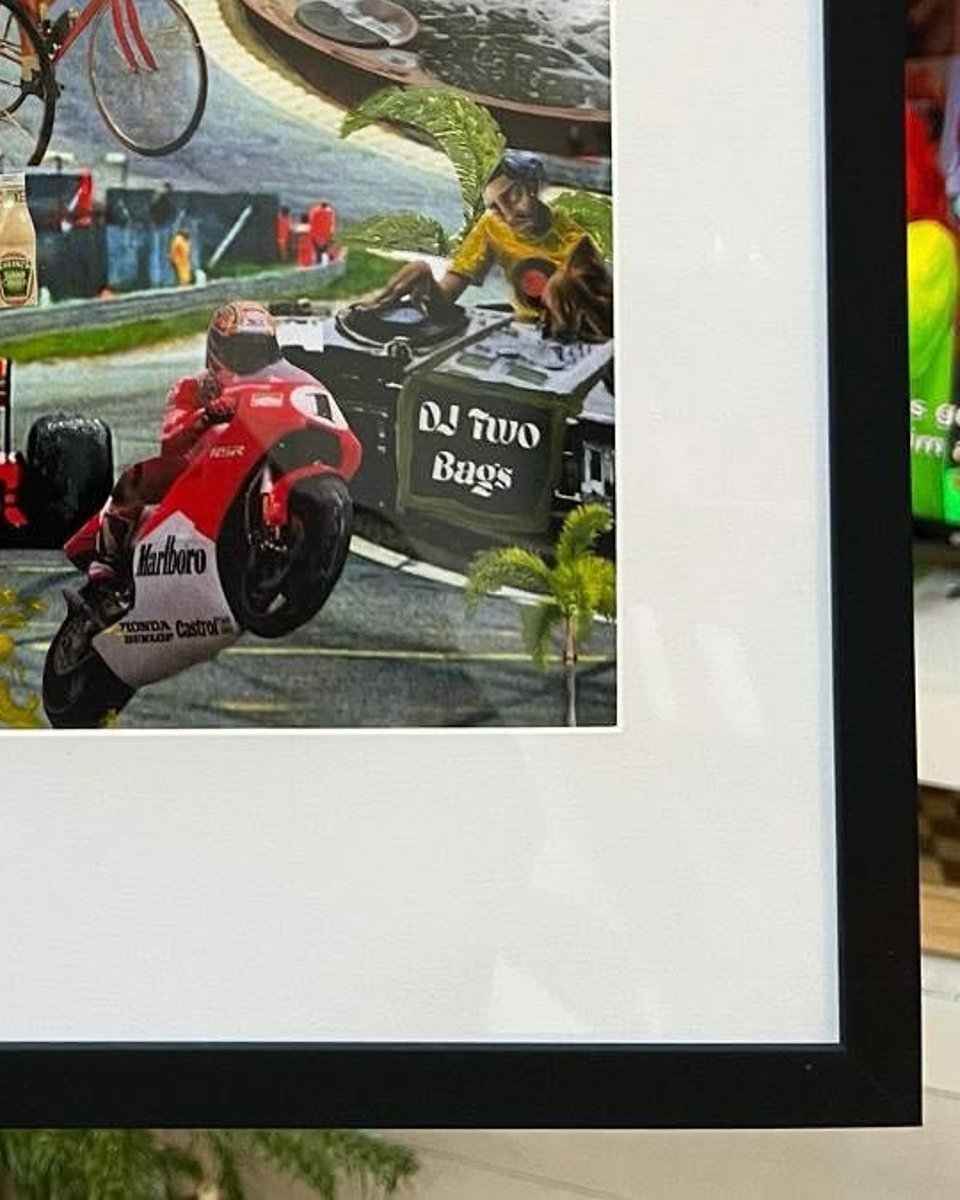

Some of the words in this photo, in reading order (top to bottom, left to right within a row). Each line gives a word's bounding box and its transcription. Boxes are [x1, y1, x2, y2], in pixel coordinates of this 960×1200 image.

[419, 401, 459, 436] DJ
[432, 451, 513, 497] Bags
[135, 534, 207, 577] Marlboro
